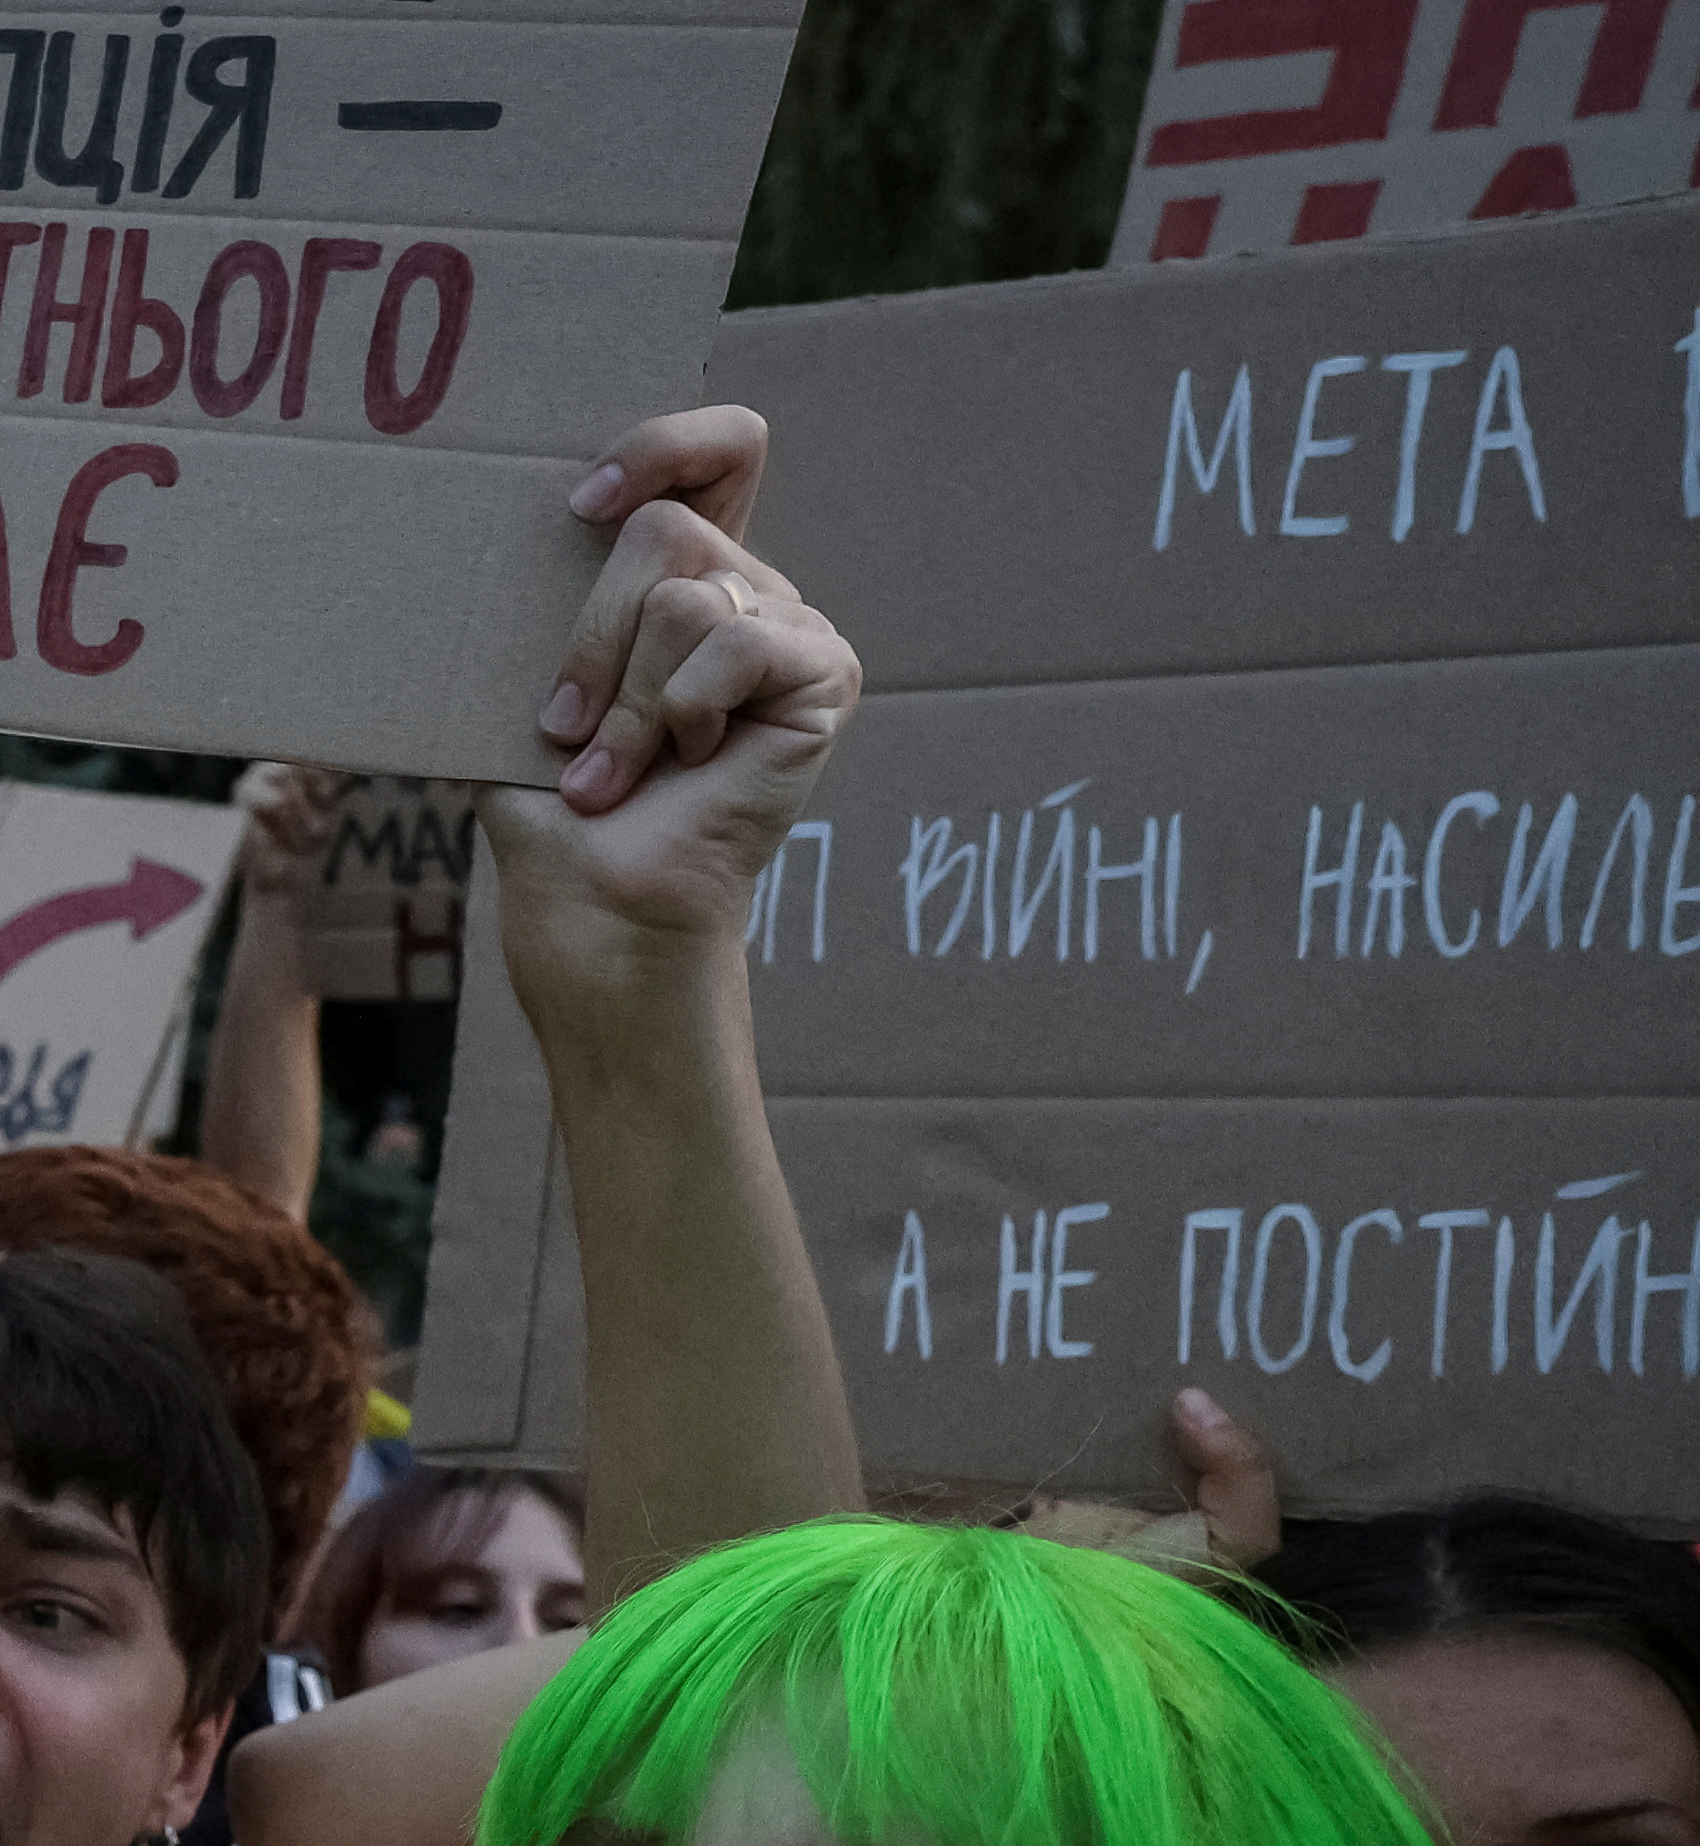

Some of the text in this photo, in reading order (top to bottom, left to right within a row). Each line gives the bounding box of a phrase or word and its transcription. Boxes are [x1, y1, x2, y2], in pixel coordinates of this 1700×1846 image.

[1151, 345, 1547, 551] МЕТА
[898, 778, 1214, 995] ВІЙНІ,
[884, 1169, 1700, 1383] А НЕ ПОСТІЙН
